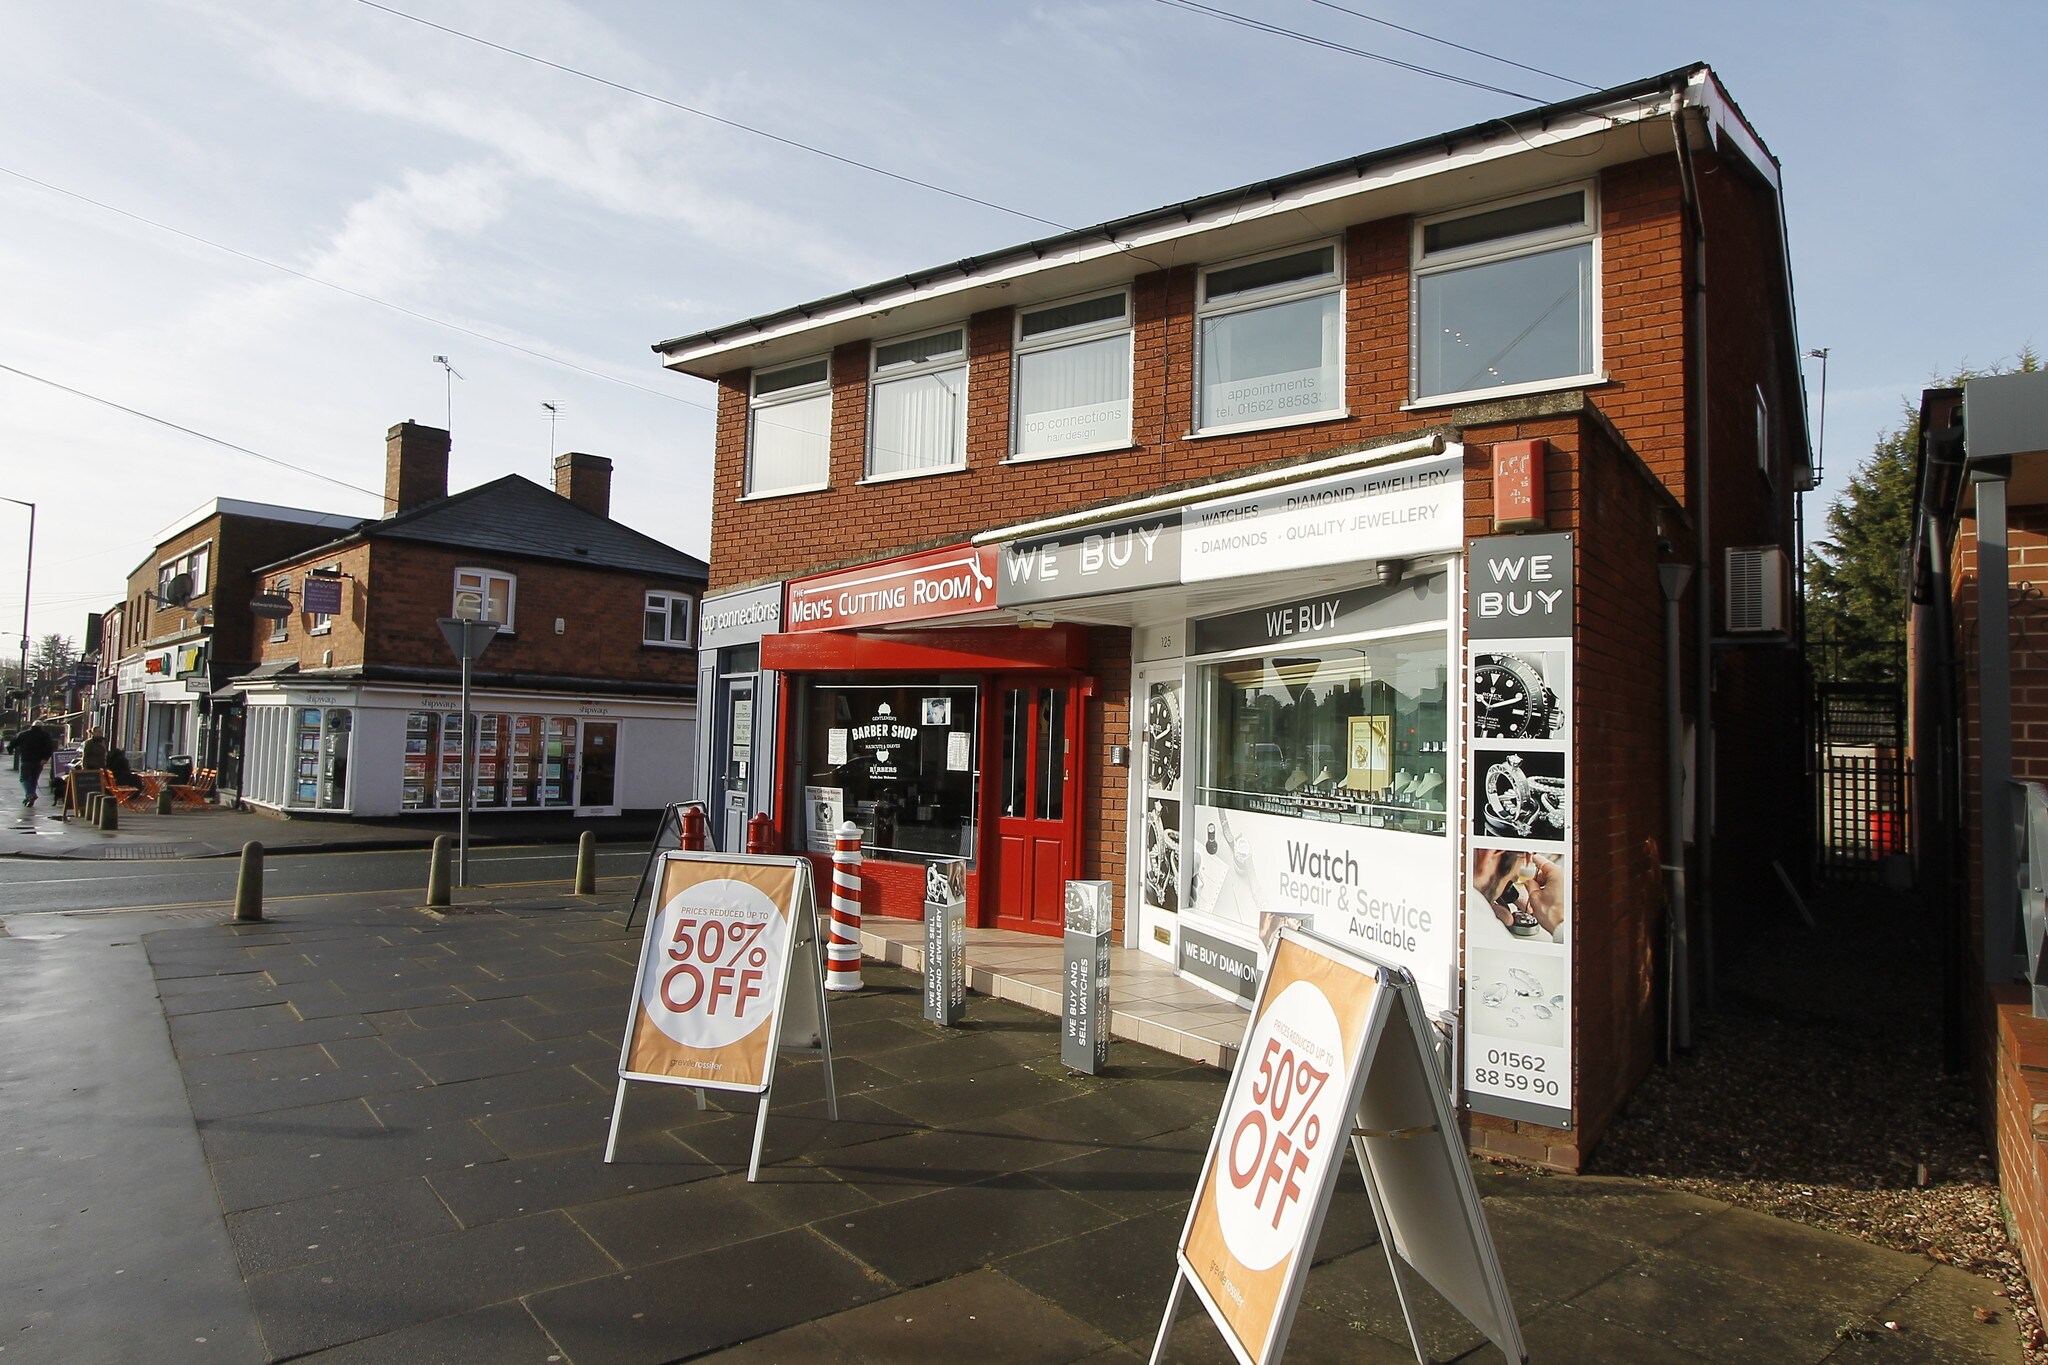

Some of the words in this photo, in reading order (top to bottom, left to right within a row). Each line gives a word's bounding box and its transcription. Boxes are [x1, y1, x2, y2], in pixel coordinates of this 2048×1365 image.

[1227, 376, 1315, 402] appointments
[1025, 418, 1045, 434] top
[1048, 406, 1122, 431] connections
[1215, 405, 1234, 418] tel.
[1237, 399, 1274, 415] 01562
[1047, 430, 1063, 443] hair
[1065, 428, 1096, 443] design
[1201, 504, 1260, 527] WATCHES
[1287, 486, 1356, 513] DIAMOND
[1360, 468, 1451, 495] JEWELLERY
[1201, 531, 1268, 554] DIAMONDS
[1286, 518, 1347, 541] QUALITY
[1350, 504, 1440, 532] JEWELLERY
[1005, 543, 1060, 587] WE
[1078, 522, 1164, 576] BUY
[1488, 554, 1553, 584] WE
[792, 599, 833, 624] MEN'S
[838, 586, 906, 617] CUTTING
[913, 575, 972, 606] ROOM
[793, 589, 804, 597] THE
[1477, 588, 1563, 619] BUY
[701, 611, 716, 636] top
[717, 601, 779, 630] connections
[1266, 608, 1294, 638] WE
[1298, 599, 1341, 634] BUY
[1161, 636, 1171, 648] 125
[306, 695, 337, 704] shipways
[421, 699, 457, 709] shipways
[579, 706, 609, 716] shipways
[852, 724, 889, 741] BARBER
[891, 724, 918, 741] SHOP
[1287, 839, 1359, 887] Watch
[681, 907, 707, 916] PRICES
[709, 908, 744, 918] REDUCED
[746, 911, 757, 919] UP
[759, 912, 769, 920] TO
[1279, 871, 1331, 908] Repair
[1338, 890, 1350, 913] &
[1357, 889, 1432, 933] Service
[668, 918, 767, 967] 50%
[1349, 916, 1416, 953] Available
[1185, 940, 1198, 960] WE
[1200, 946, 1218, 967] BUY
[660, 963, 763, 1018] OFF
[929, 990, 935, 1007] WE
[952, 992, 956, 1008] WE
[1079, 958, 1088, 1015] WATCHES
[1069, 990, 1078, 1016] BUY
[1069, 1018, 1077, 1037] WE
[1079, 1018, 1087, 1047] SELL
[1273, 1018, 1290, 1039] PRICES
[1289, 1029, 1316, 1055] REDUCED
[1315, 1046, 1326, 1061] UP
[1326, 1052, 1334, 1067] TO
[1488, 1049, 1546, 1072] 01562
[1253, 1037, 1329, 1150] 50%
[1229, 1108, 1310, 1231] OFF
